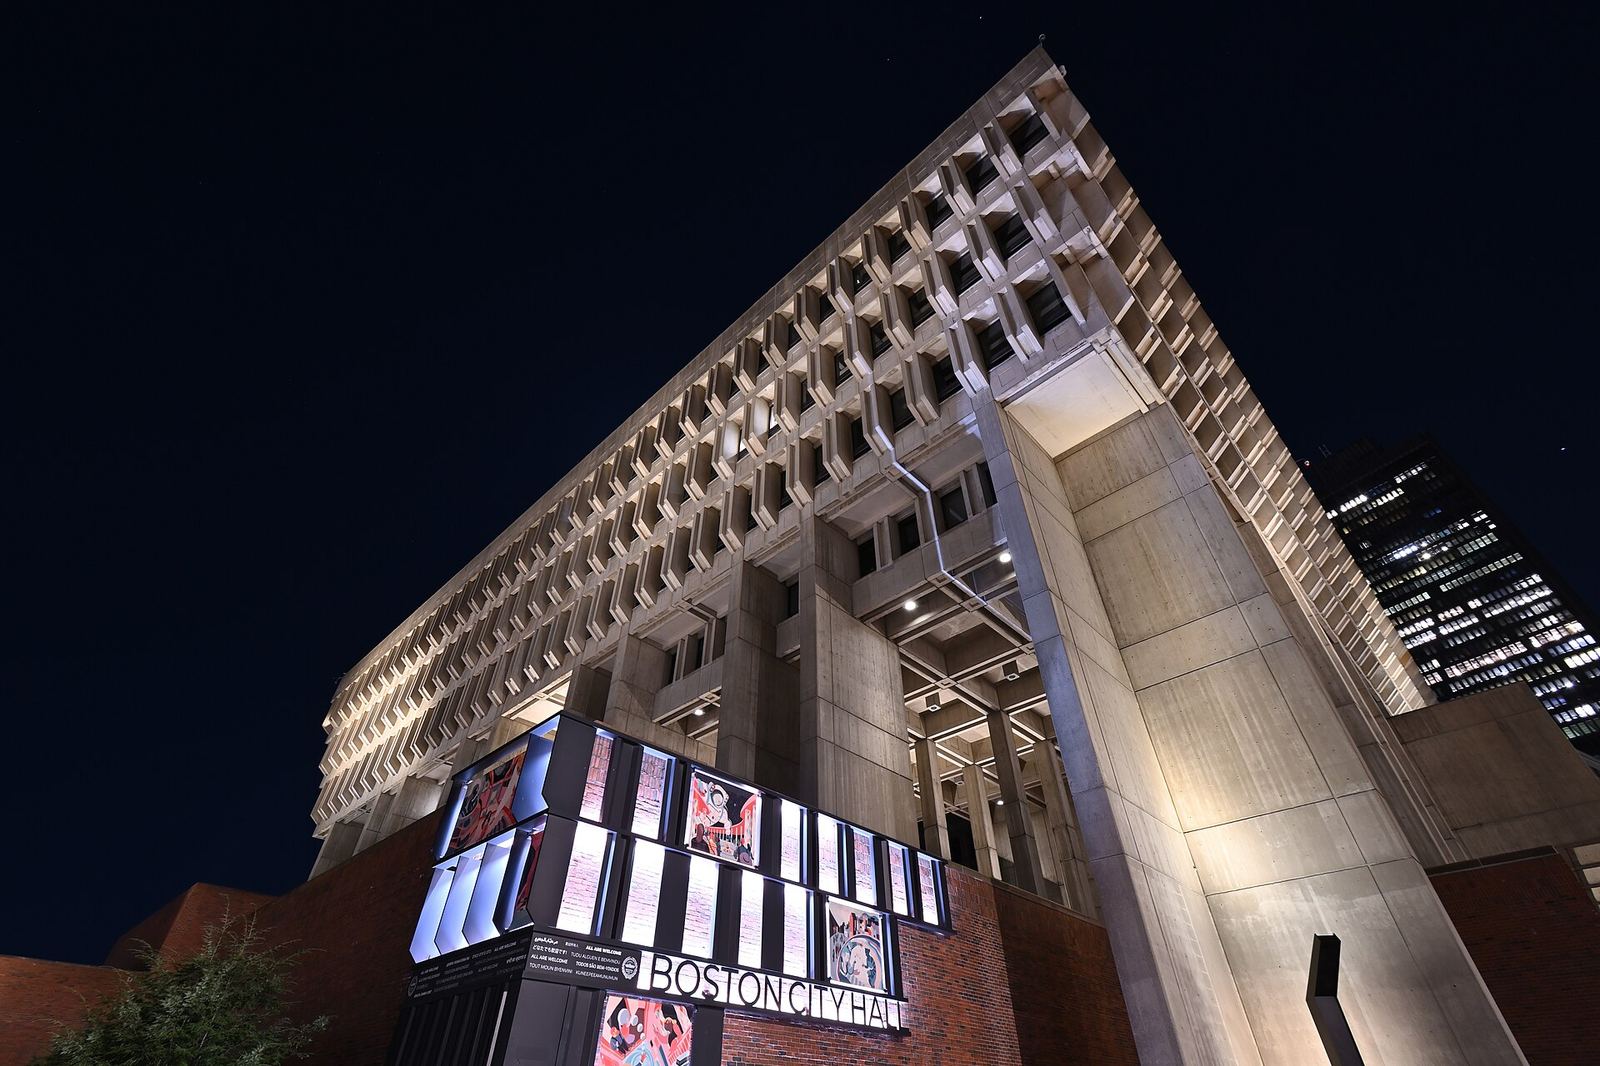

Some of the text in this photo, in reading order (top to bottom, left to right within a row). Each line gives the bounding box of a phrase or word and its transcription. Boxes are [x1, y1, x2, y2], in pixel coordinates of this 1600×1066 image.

[548, 956, 568, 964] WELCOME
[650, 955, 901, 1030] BOSTON CITY HALL
